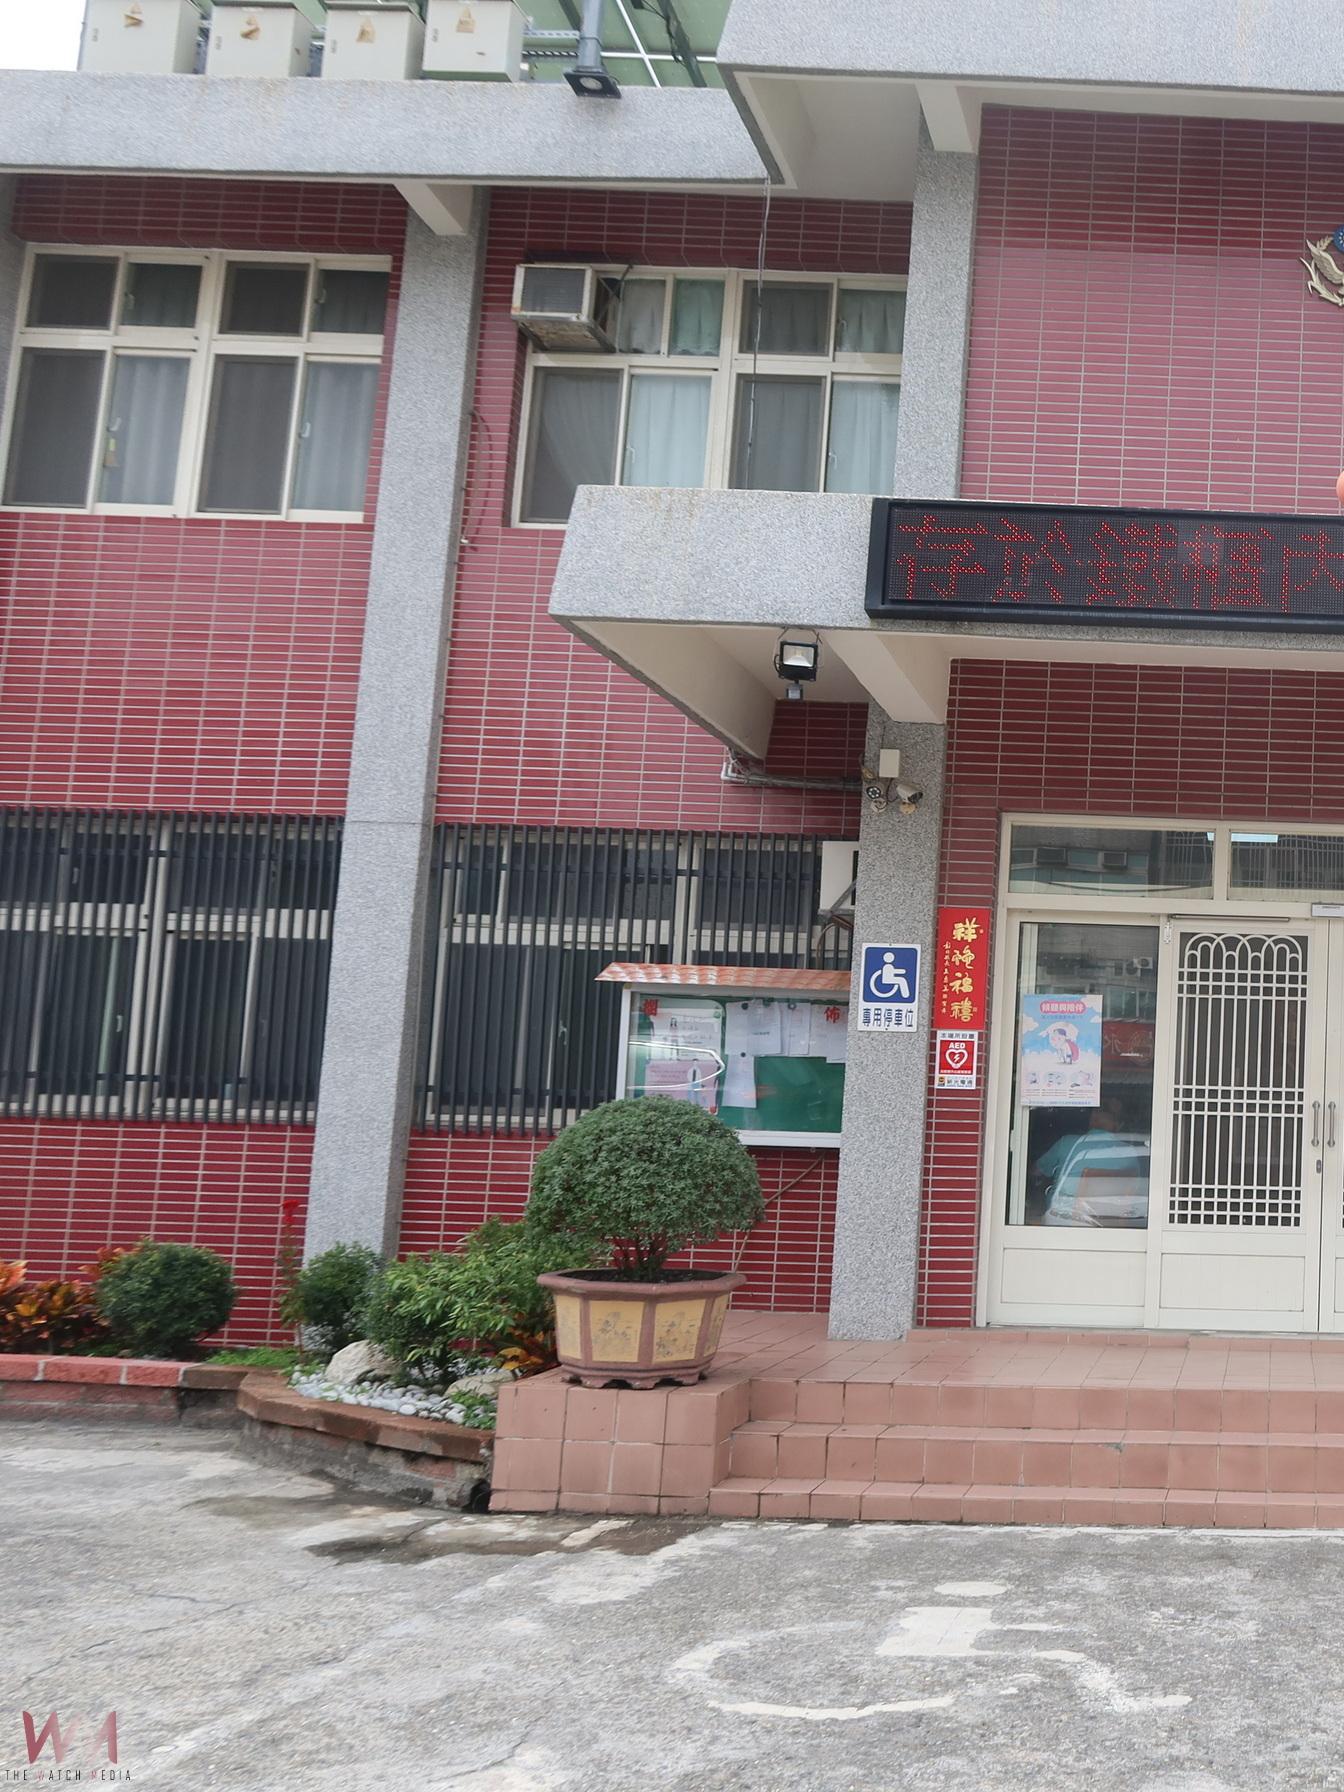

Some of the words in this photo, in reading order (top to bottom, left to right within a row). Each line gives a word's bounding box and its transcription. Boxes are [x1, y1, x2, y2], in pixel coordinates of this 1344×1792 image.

[863, 1008, 914, 1028] 專用停車位
